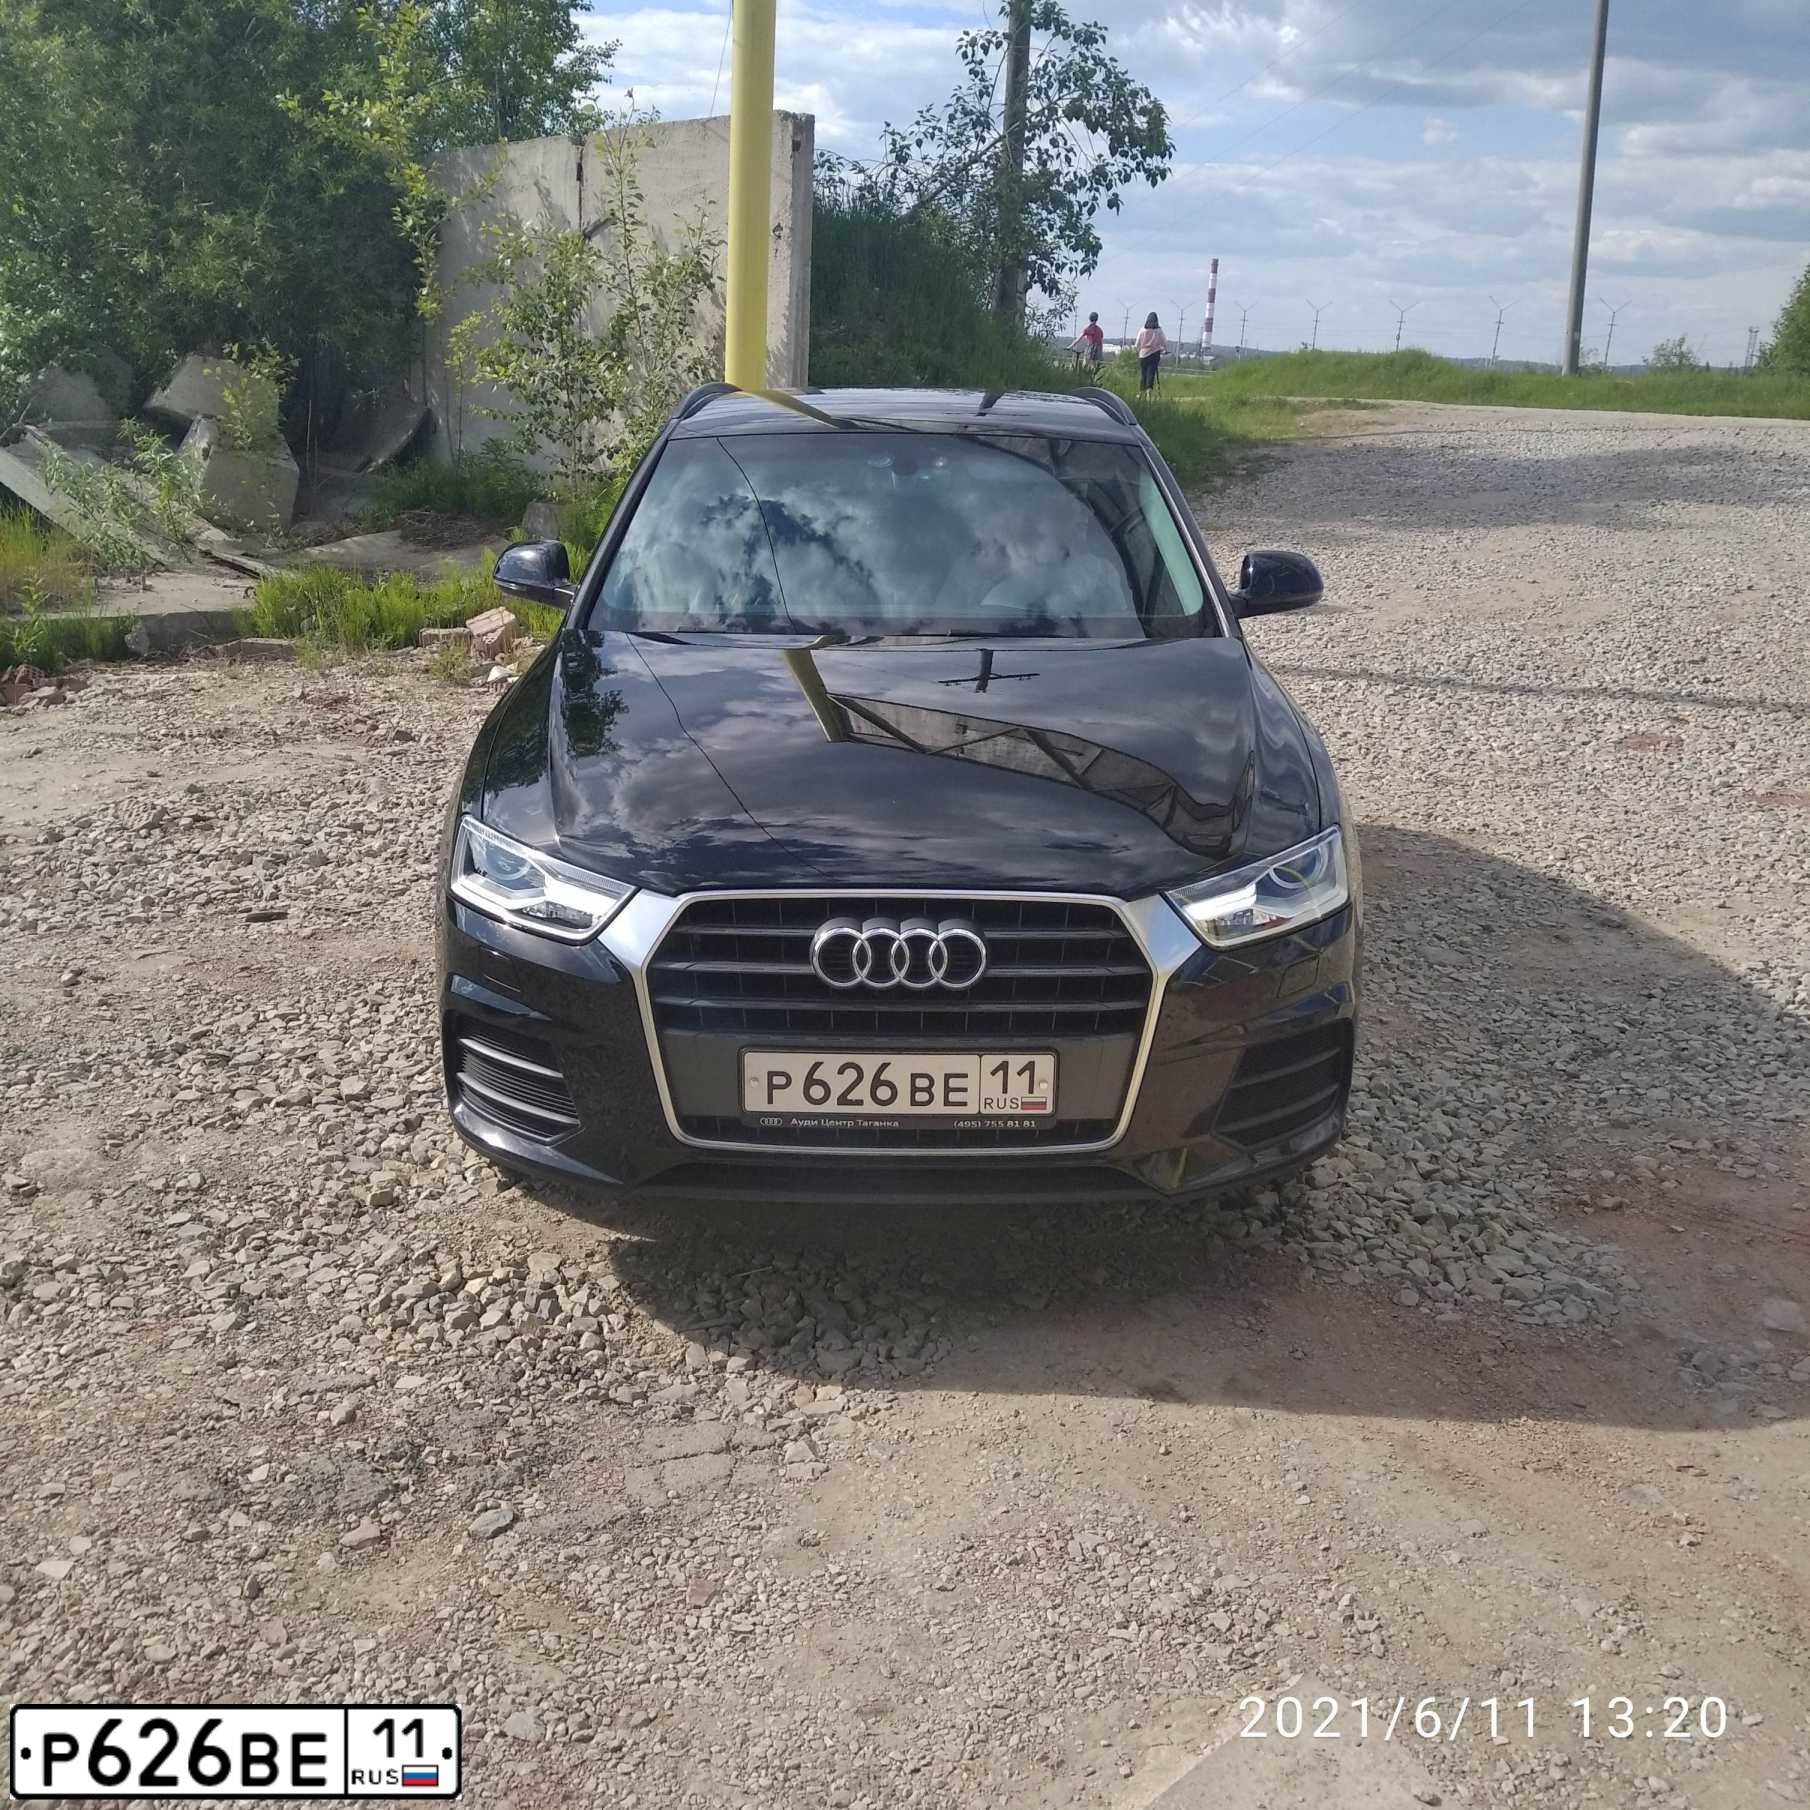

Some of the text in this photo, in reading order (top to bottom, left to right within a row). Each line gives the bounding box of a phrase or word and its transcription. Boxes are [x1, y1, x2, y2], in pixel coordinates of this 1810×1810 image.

[989, 1060, 1035, 1095] 11
[983, 1097, 1019, 1110] RUS
[790, 1118, 899, 1129] Ауди Центр Таганка
[953, 1119, 981, 1129] (495)
[1006, 1120, 1020, 1128] 81
[1023, 1120, 1036, 1128] 81
